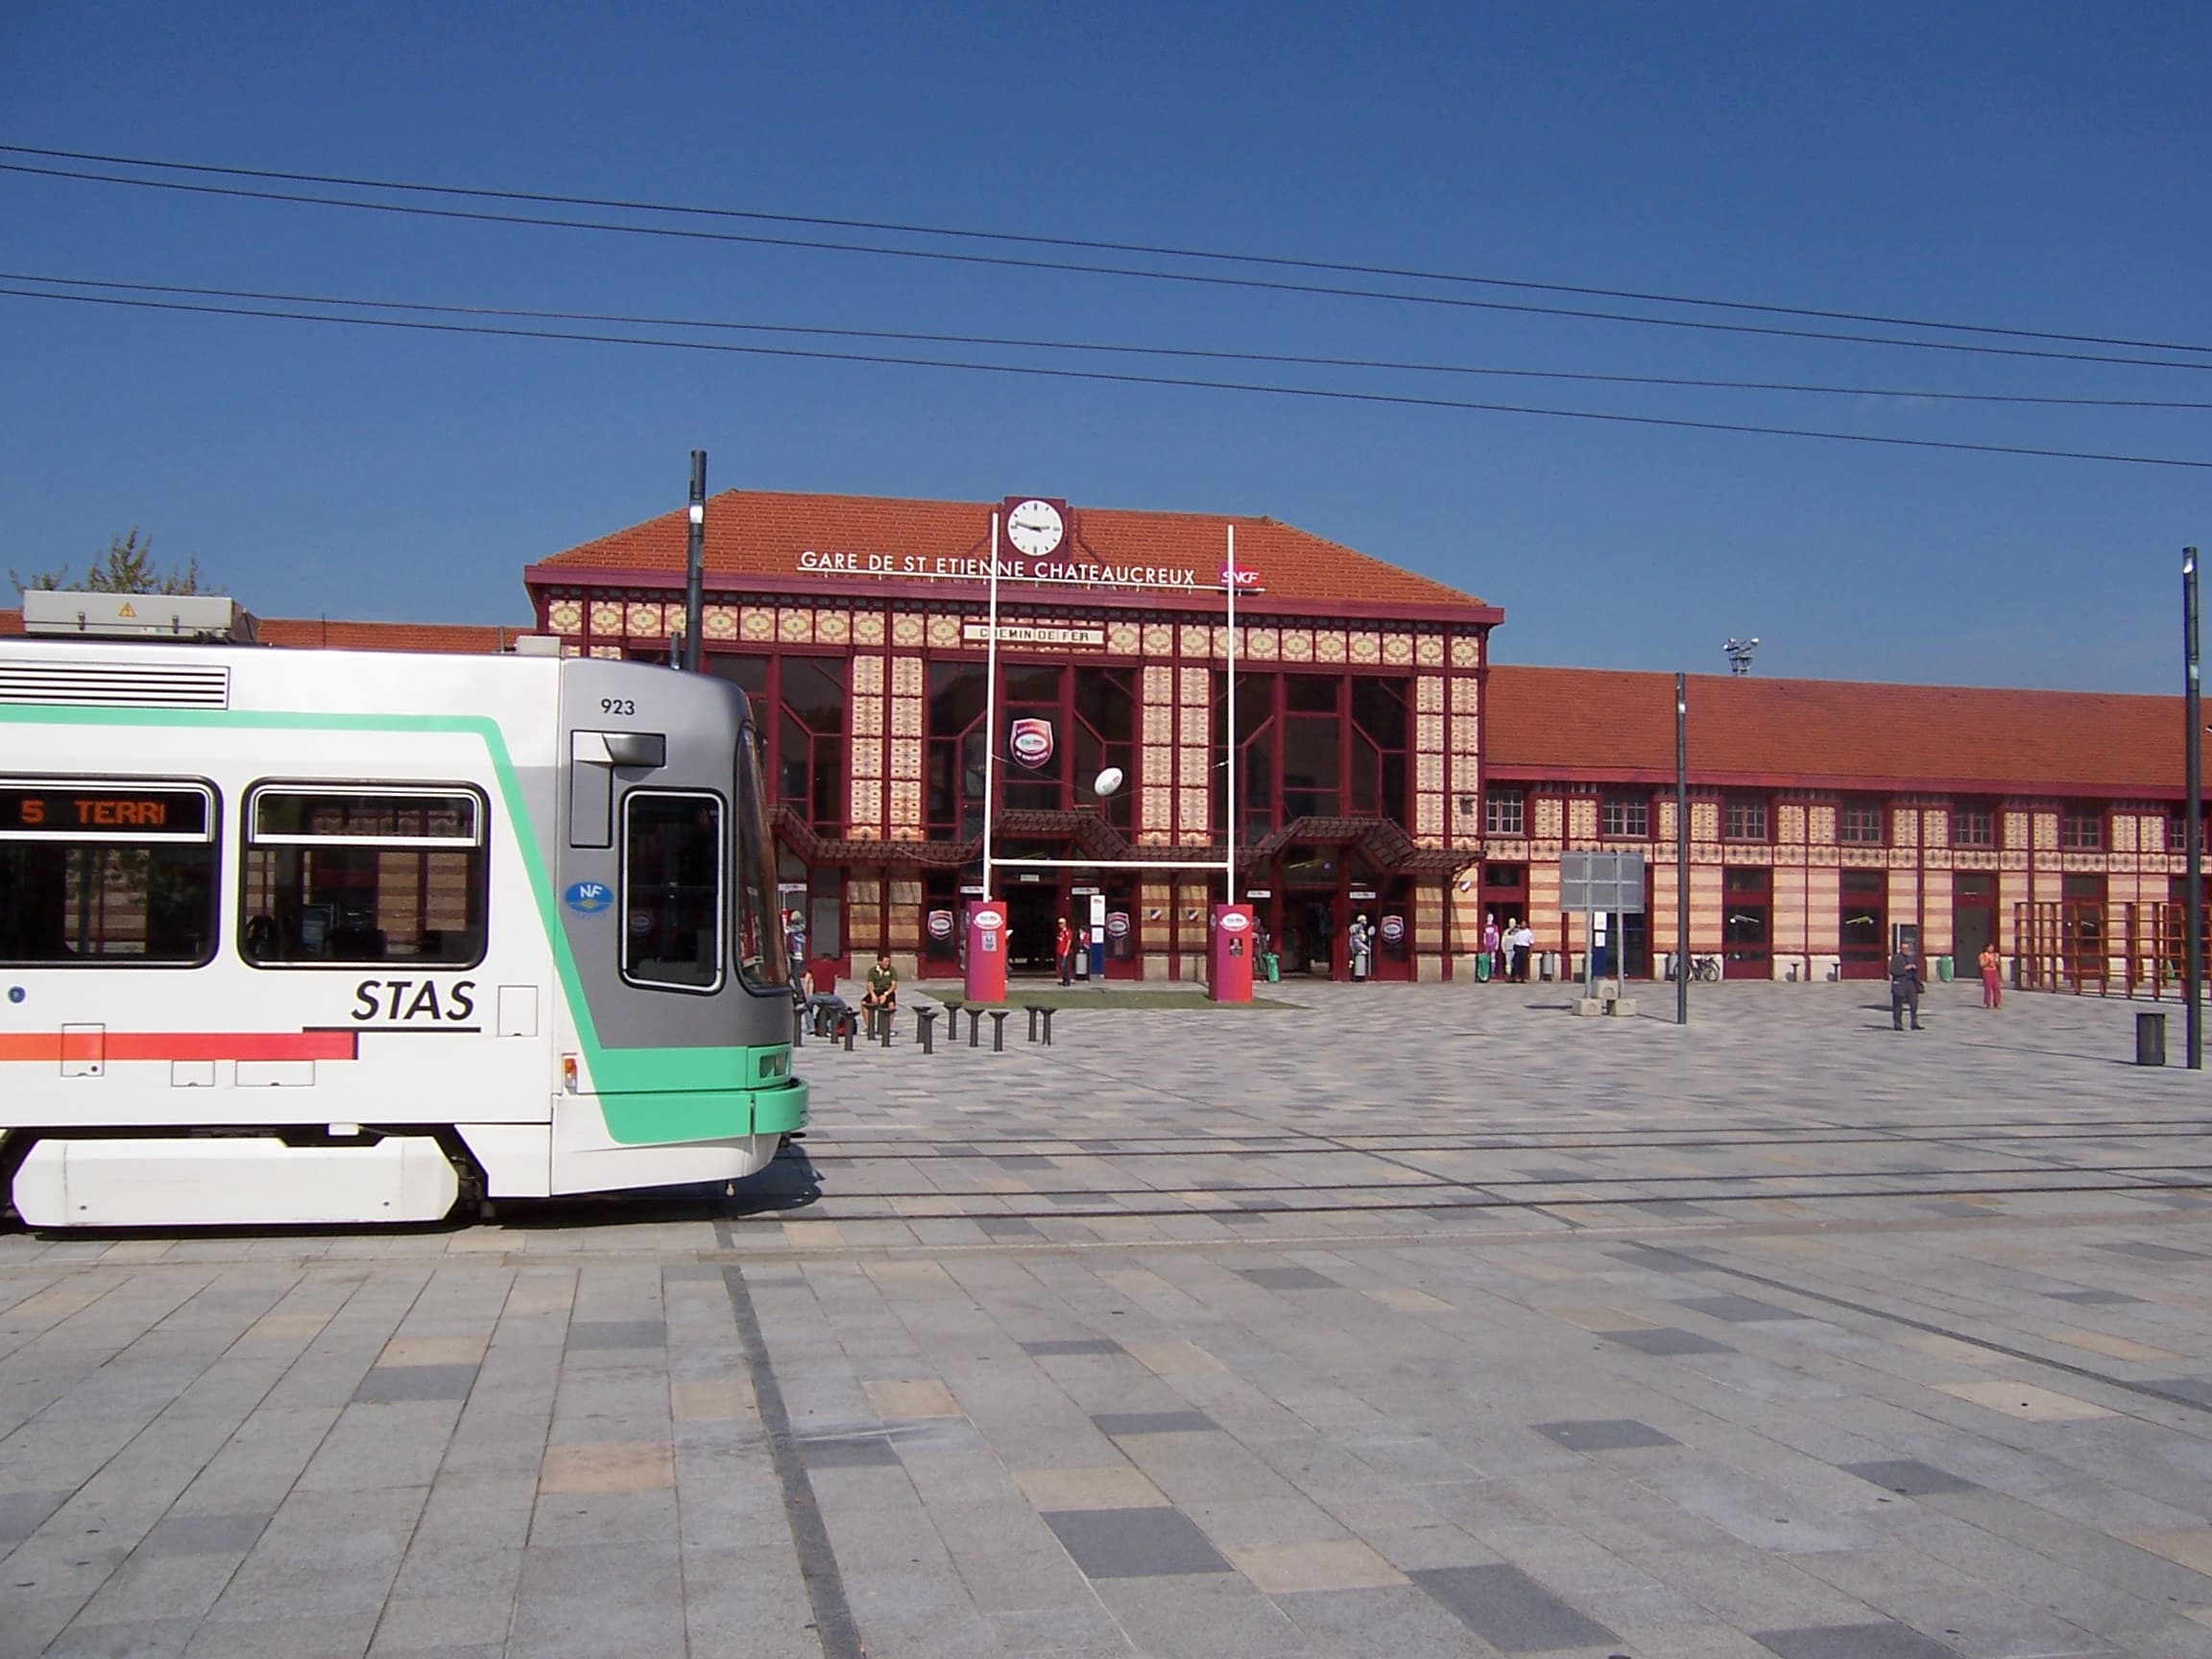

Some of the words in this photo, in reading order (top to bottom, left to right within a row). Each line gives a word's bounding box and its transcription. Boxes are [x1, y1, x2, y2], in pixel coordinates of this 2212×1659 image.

[801, 551, 857, 568] GARE
[869, 554, 894, 571] DE
[903, 556, 926, 572] ST
[936, 558, 1024, 576] ETIENNE
[1034, 562, 1195, 586] CHATEAUCREUX
[1220, 571, 1261, 584] SNCF
[979, 628, 1032, 639] CEMIN
[1038, 630, 1055, 639] DE
[1062, 631, 1090, 641] FER
[601, 698, 636, 715] 923
[21, 799, 45, 823] 5
[579, 884, 604, 899] NF
[351, 979, 477, 1021] STAS
